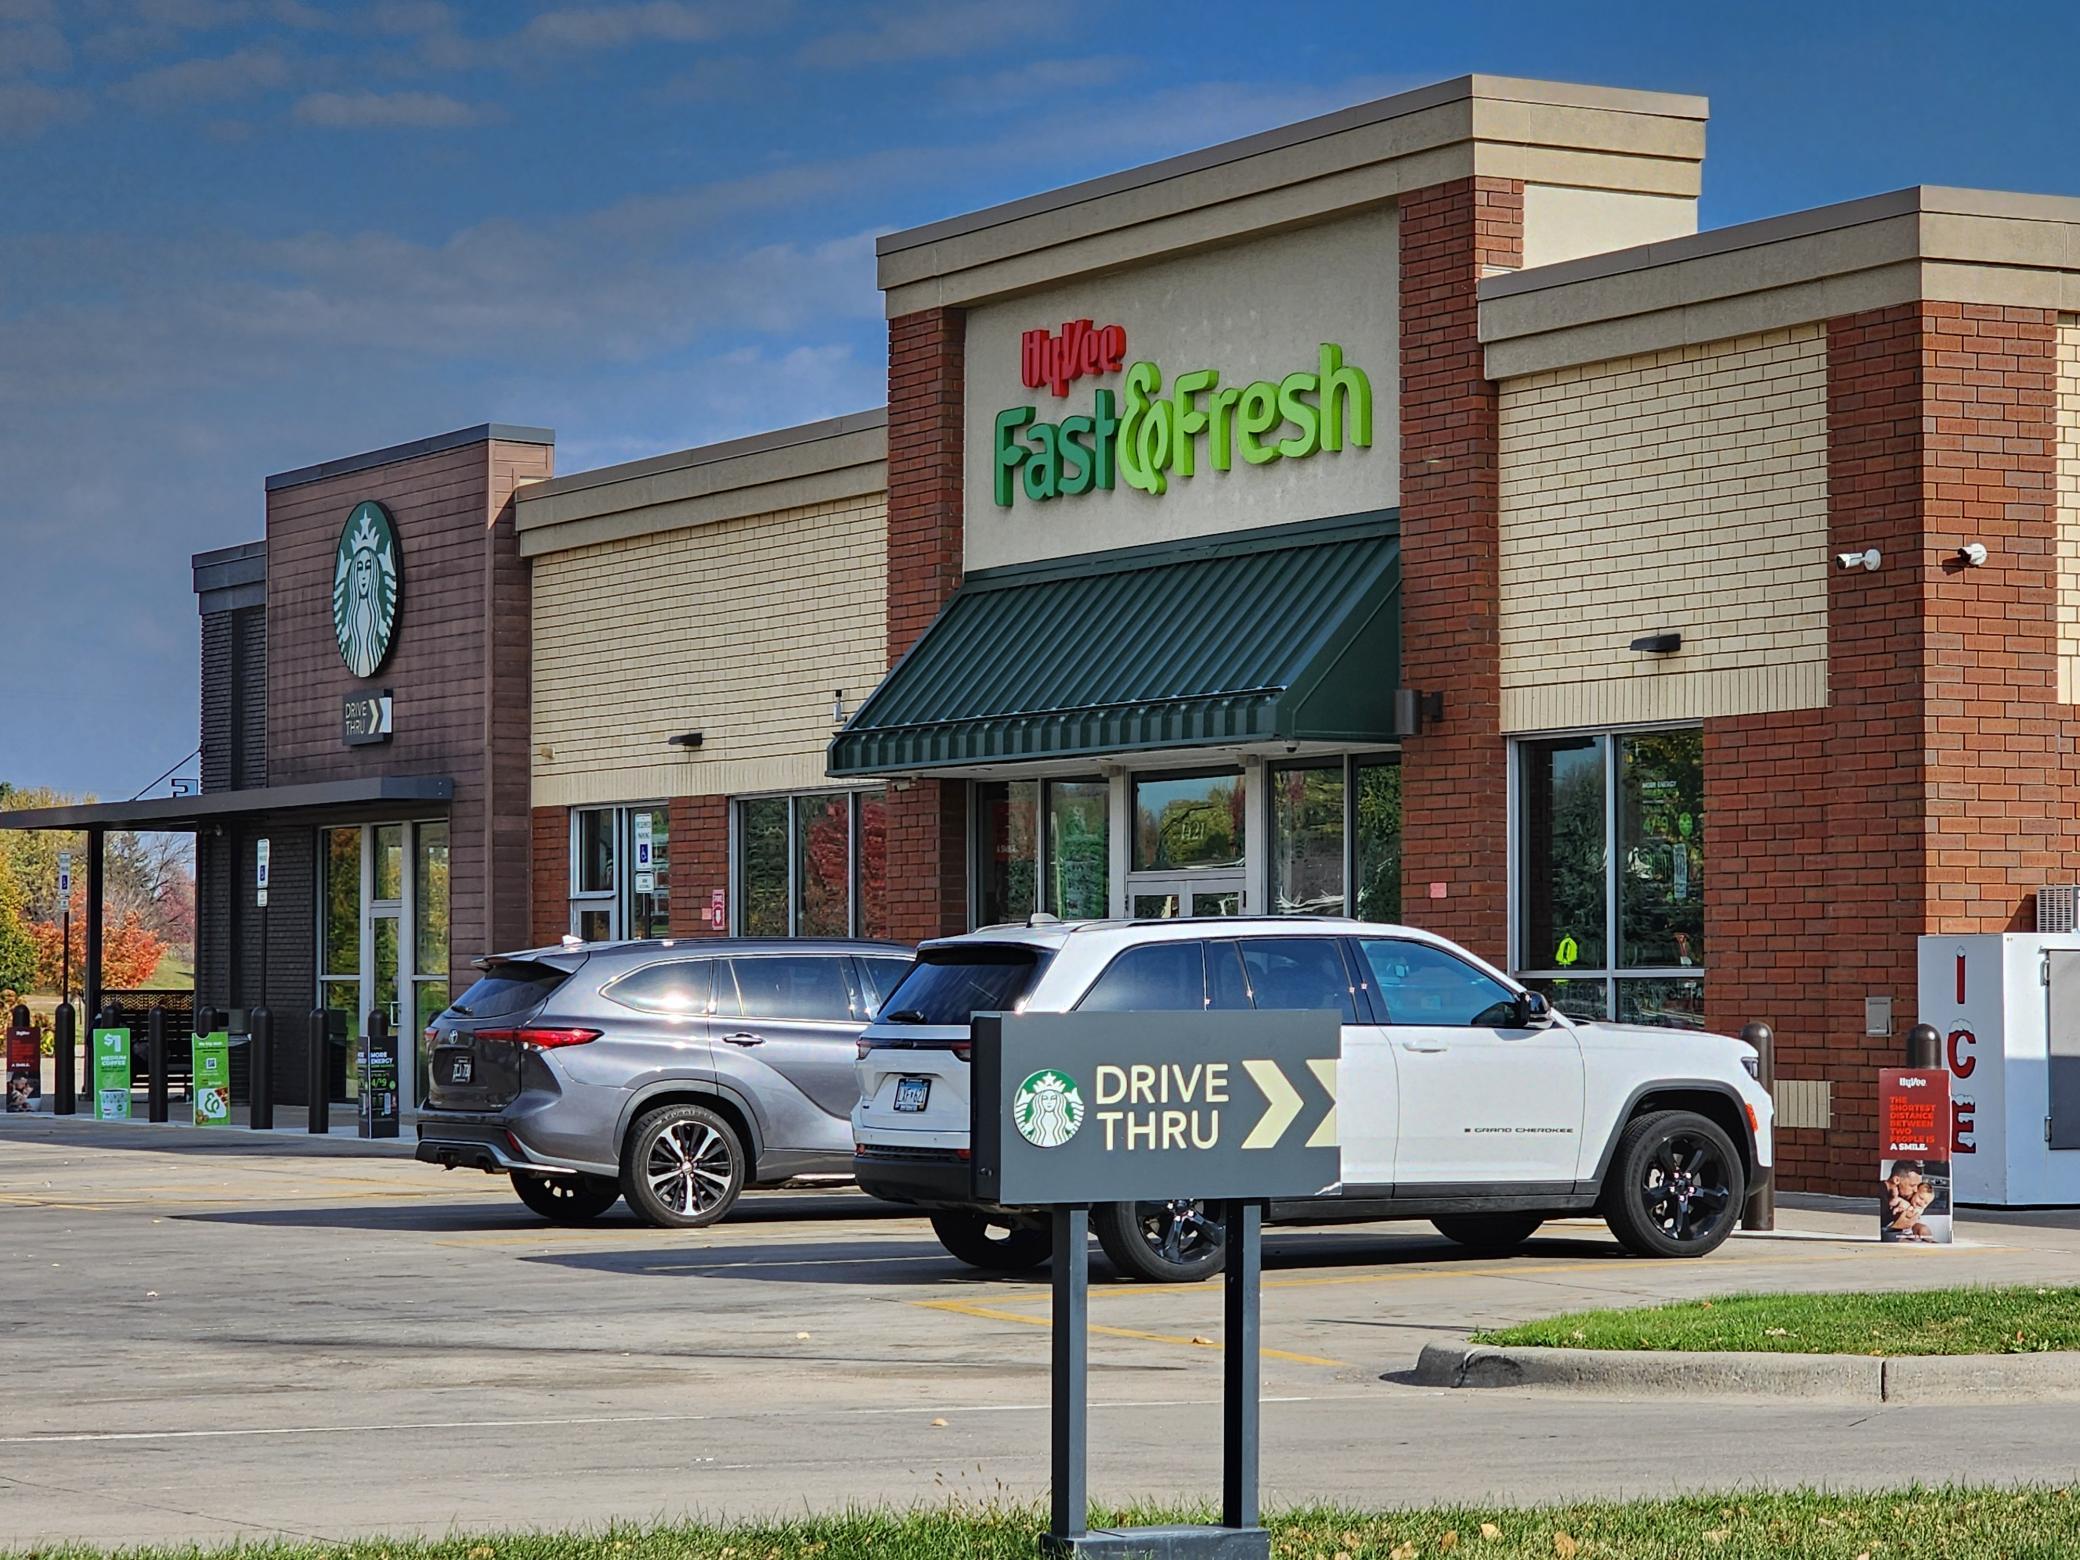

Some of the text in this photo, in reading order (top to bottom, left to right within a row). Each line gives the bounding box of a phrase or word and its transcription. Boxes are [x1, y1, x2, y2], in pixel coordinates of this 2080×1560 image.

[1173, 342, 1372, 477] Fresh
[345, 701, 367, 718] DRIVE
[345, 719, 366, 735] THRU
[1096, 1063, 1229, 1105] DRIVE
[1096, 1110, 1220, 1151] THRU
[1890, 1143, 1898, 1151] A
